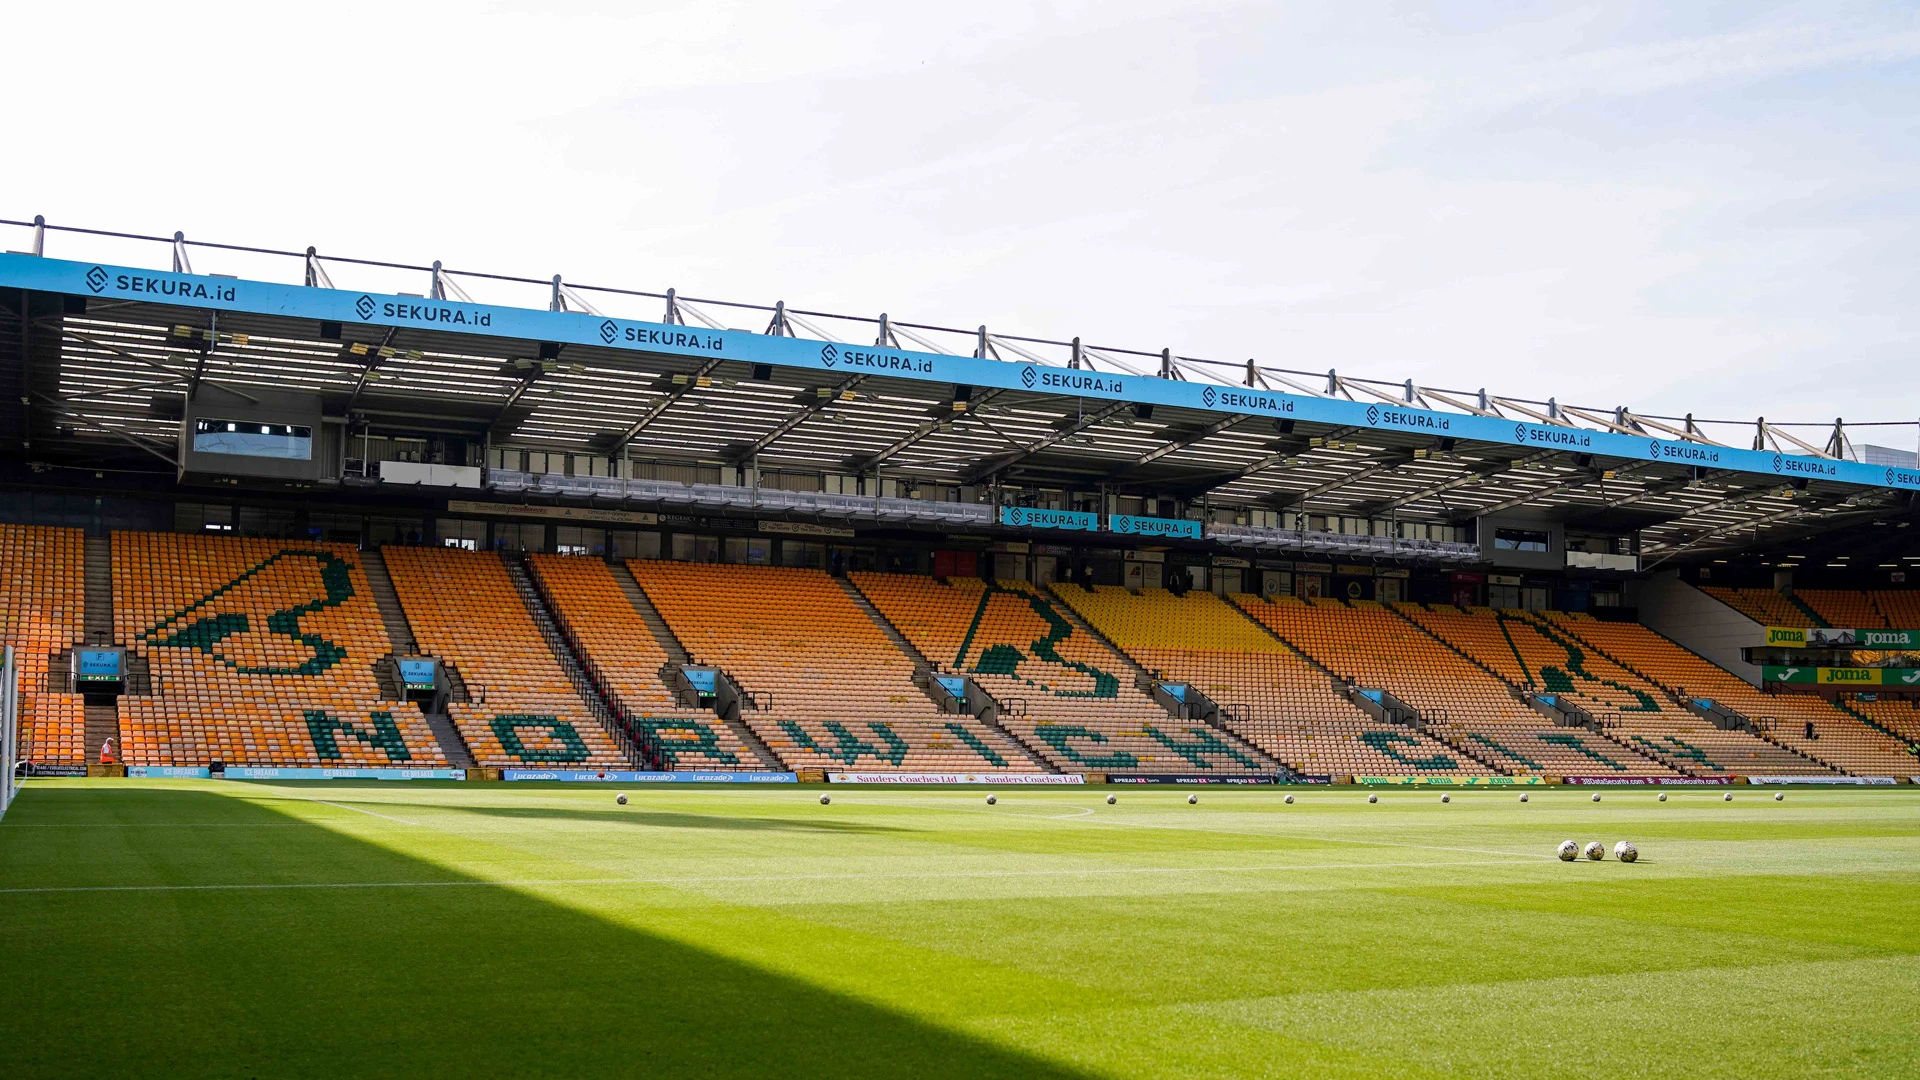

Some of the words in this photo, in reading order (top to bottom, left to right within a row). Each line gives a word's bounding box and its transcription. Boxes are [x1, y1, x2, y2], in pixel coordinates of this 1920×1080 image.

[117, 275, 235, 301] SEKURA.id
[384, 303, 490, 326] SEKURA.id
[625, 328, 722, 350] SEKURA.id
[844, 352, 932, 372] SEKURA.id
[1042, 373, 1122, 393] SEKURA.id
[1221, 393, 1293, 412] SEKURA.id
[1383, 412, 1449, 429] SEKURA.id
[1530, 429, 1590, 446] SEKURA.id
[1663, 446, 1719, 461] SEKURA.id
[1785, 460, 1836, 474] SEKURA.id
[1026, 512, 1089, 527] SEKURA.id
[1134, 520, 1193, 535] SEKURA.id
[1769, 629, 1804, 643] Joma
[1864, 632, 1911, 646] Joma
[1826, 669, 1872, 682] Joma
[244, 768, 253, 776] ICE
[253, 768, 279, 776] BREAKER
[857, 775, 897, 783] Sanders
[899, 775, 940, 783] Coaches
[1024, 776, 1062, 784] Coaches
[1063, 776, 1079, 784] Ltd
